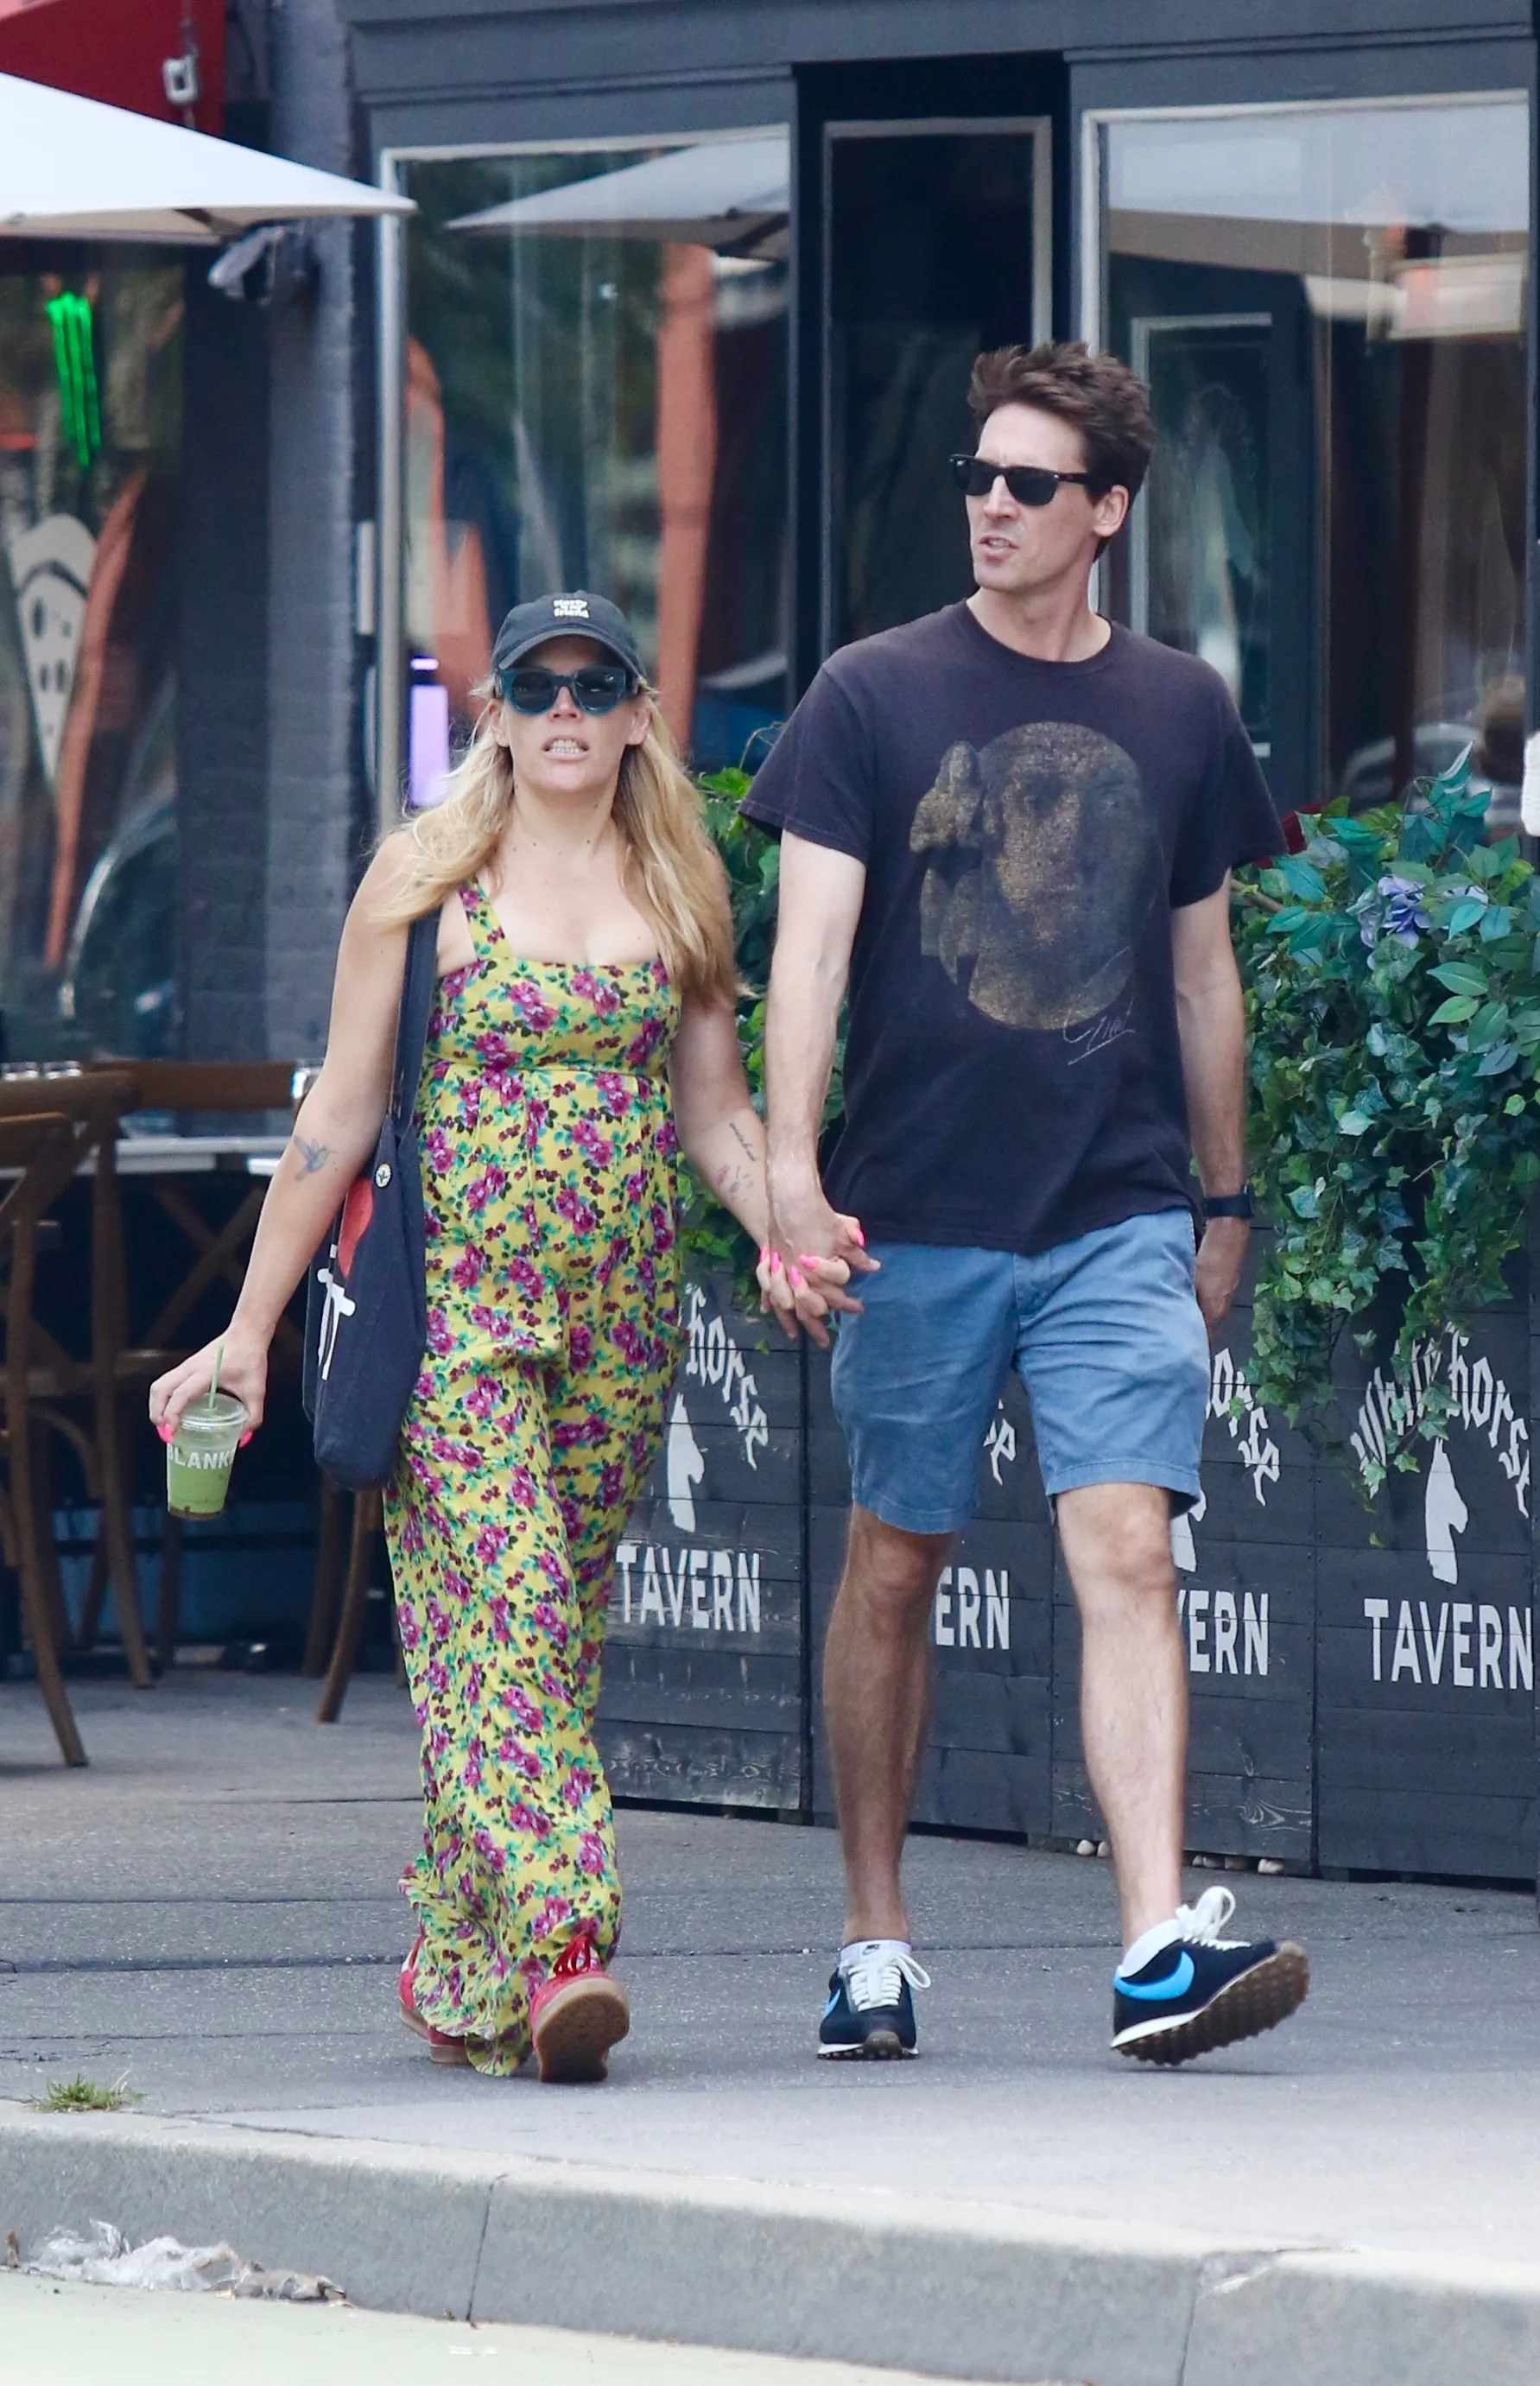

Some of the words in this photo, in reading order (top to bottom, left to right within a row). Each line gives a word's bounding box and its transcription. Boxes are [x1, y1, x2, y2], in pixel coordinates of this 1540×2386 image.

[1206, 1348, 1280, 1507] orse
[616, 1545, 760, 1634] TAVERN
[935, 1566, 1011, 1650] ERN
[1364, 1598, 1533, 1691] TAVERN
